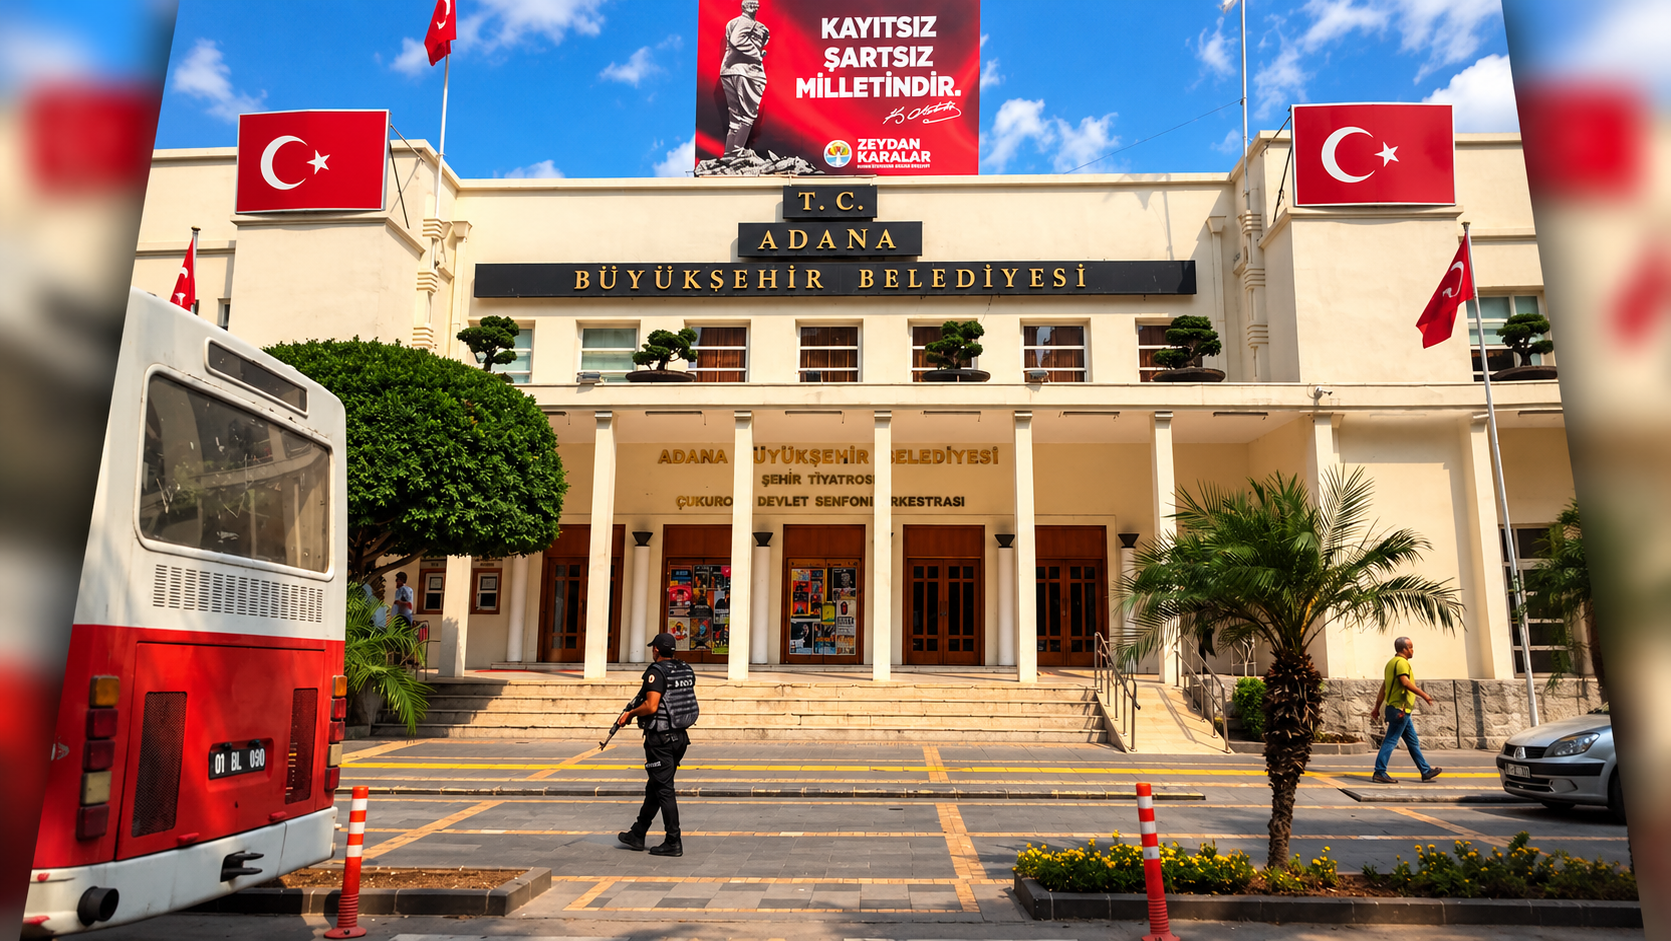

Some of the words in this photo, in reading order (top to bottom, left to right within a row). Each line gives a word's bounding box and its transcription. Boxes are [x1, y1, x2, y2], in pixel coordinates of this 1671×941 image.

[821, 15, 937, 39] KAYITSIZ
[823, 46, 934, 72] ŞARTSIZ
[795, 70, 962, 98] MİLLETİNDİR.
[857, 138, 921, 150] ZEYDAN
[857, 150, 931, 163] KARALAR
[757, 228, 897, 250] ADANA
[573, 264, 824, 292] BÜYÜKŞEHİR
[858, 263, 1087, 289] BELEDİYESİ
[657, 448, 729, 464] ADANA
[753, 445, 870, 467] ÜYÜKŞEHİR
[761, 468, 802, 487] ŞEHİR
[807, 471, 875, 485] TİYATROS
[757, 496, 809, 507] DEVLET
[815, 492, 874, 507] SENFONİ
[891, 495, 965, 507] RKESTRASI
[214, 753, 225, 774] 01
[231, 751, 242, 771] BL
